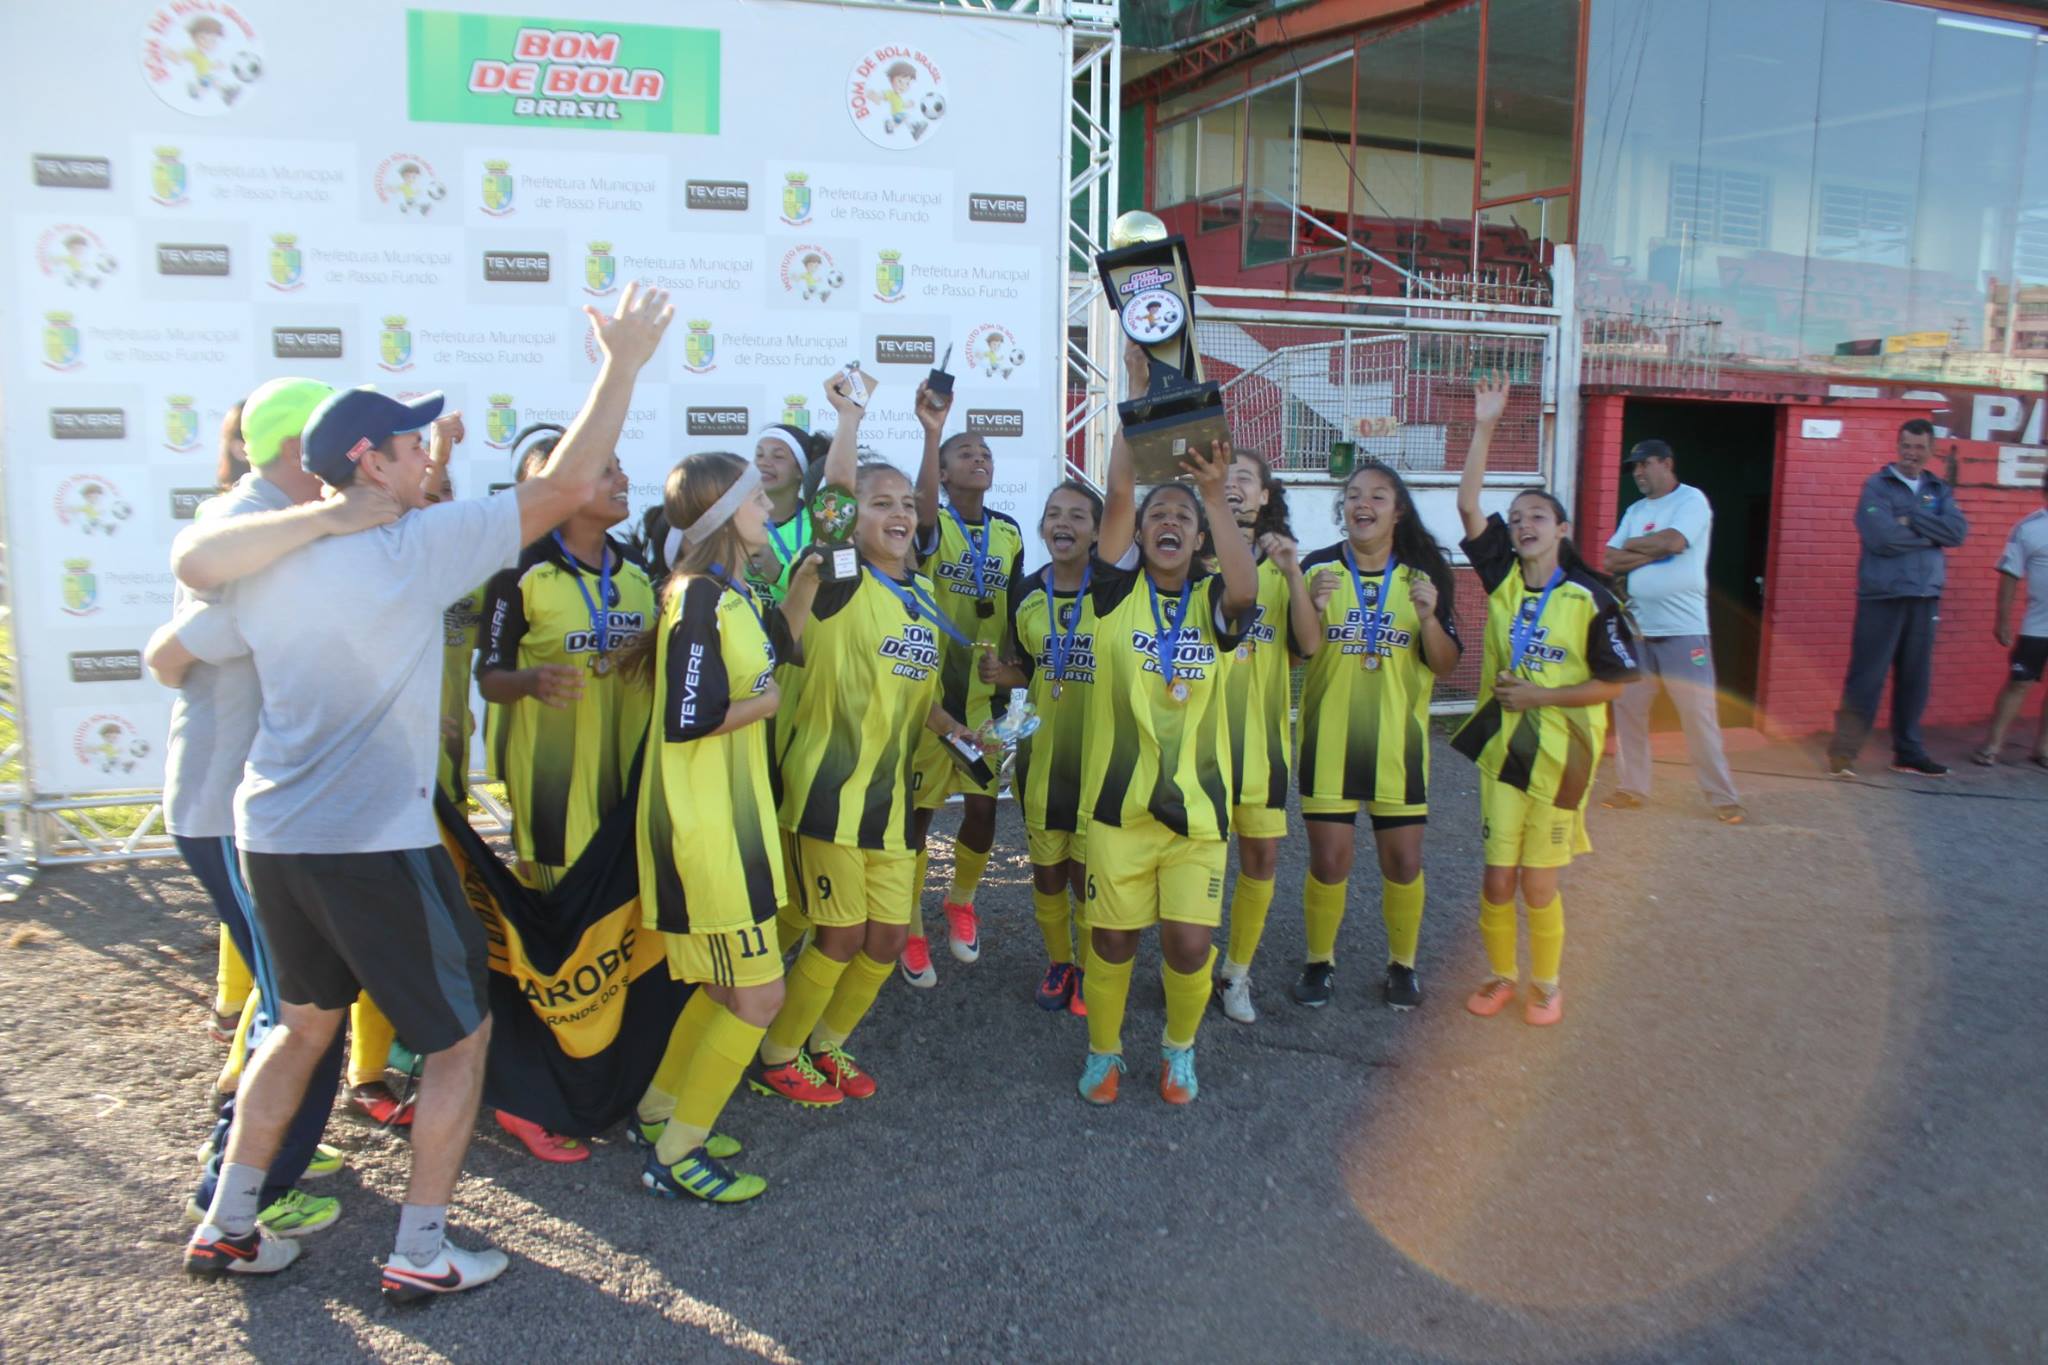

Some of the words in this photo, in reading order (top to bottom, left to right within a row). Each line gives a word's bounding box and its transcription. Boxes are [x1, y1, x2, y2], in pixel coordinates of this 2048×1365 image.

[517, 31, 617, 62] BOM
[874, 46, 911, 62] BOLA
[857, 57, 877, 78] DE
[472, 64, 537, 91] DE
[547, 67, 661, 97] BOLA
[514, 98, 621, 119] BRASIL
[851, 81, 870, 120] BOM
[520, 174, 586, 191] Prefeitura
[589, 177, 656, 195] Municipal
[687, 185, 746, 198] TEVERE
[534, 194, 553, 209] de
[556, 194, 595, 210] Passo
[598, 196, 643, 211] Fundo
[818, 186, 878, 201] Prefeitura
[881, 190, 943, 207] Municipal
[971, 199, 1025, 211] TEVERE
[830, 205, 847, 219] de
[850, 207, 886, 221] Passo
[889, 208, 930, 223] Fundo
[158, 251, 227, 263] TEVERE
[310, 247, 379, 264] Prefeitura
[383, 249, 453, 267] Municipal
[485, 257, 548, 269] TEVERE
[623, 255, 686, 270] Prefeitura
[690, 257, 753, 274] Municipal
[325, 269, 344, 283] de
[349, 270, 386, 284] Passo
[391, 270, 439, 285] Fundo
[910, 264, 968, 279] Prefeitura
[971, 266, 1030, 282] Municipal
[637, 275, 655, 289] de
[657, 276, 695, 290] Passo
[698, 277, 741, 291] Fundo
[922, 284, 938, 297] de
[941, 284, 975, 298] Passo
[978, 285, 1019, 299] Fundo
[275, 333, 340, 345] TEVERE
[419, 330, 485, 345] Prefeitura
[489, 331, 556, 347] Municipal
[721, 333, 783, 347] Prefeitura
[786, 334, 848, 350] Municipal
[878, 340, 933, 351] TEVERE
[433, 350, 450, 363] de
[454, 350, 495, 364] Passo
[499, 351, 544, 365] Fundo
[734, 352, 754, 366] de
[757, 353, 791, 367] Passo
[794, 354, 836, 368] Fundo
[51, 413, 123, 426] TEVERE
[688, 412, 746, 423] TEVERE
[968, 414, 1021, 425] TEVERE
[960, 551, 1002, 571] BM
[937, 562, 969, 580] DE
[949, 583, 997, 599] BRAIL
[1327, 626, 1356, 641] DE
[880, 638, 908, 659] DE
[1524, 642, 1567, 663] OLA
[71, 656, 139, 668] TEVERE
[1143, 659, 1206, 680] BSIL
[680, 642, 704, 728] TEVERE
[1045, 671, 1094, 684] BASIL
[816, 875, 832, 900] 9
[1086, 872, 1096, 901] 6
[736, 926, 769, 958] 11
[546, 1003, 600, 1026] RANDE
